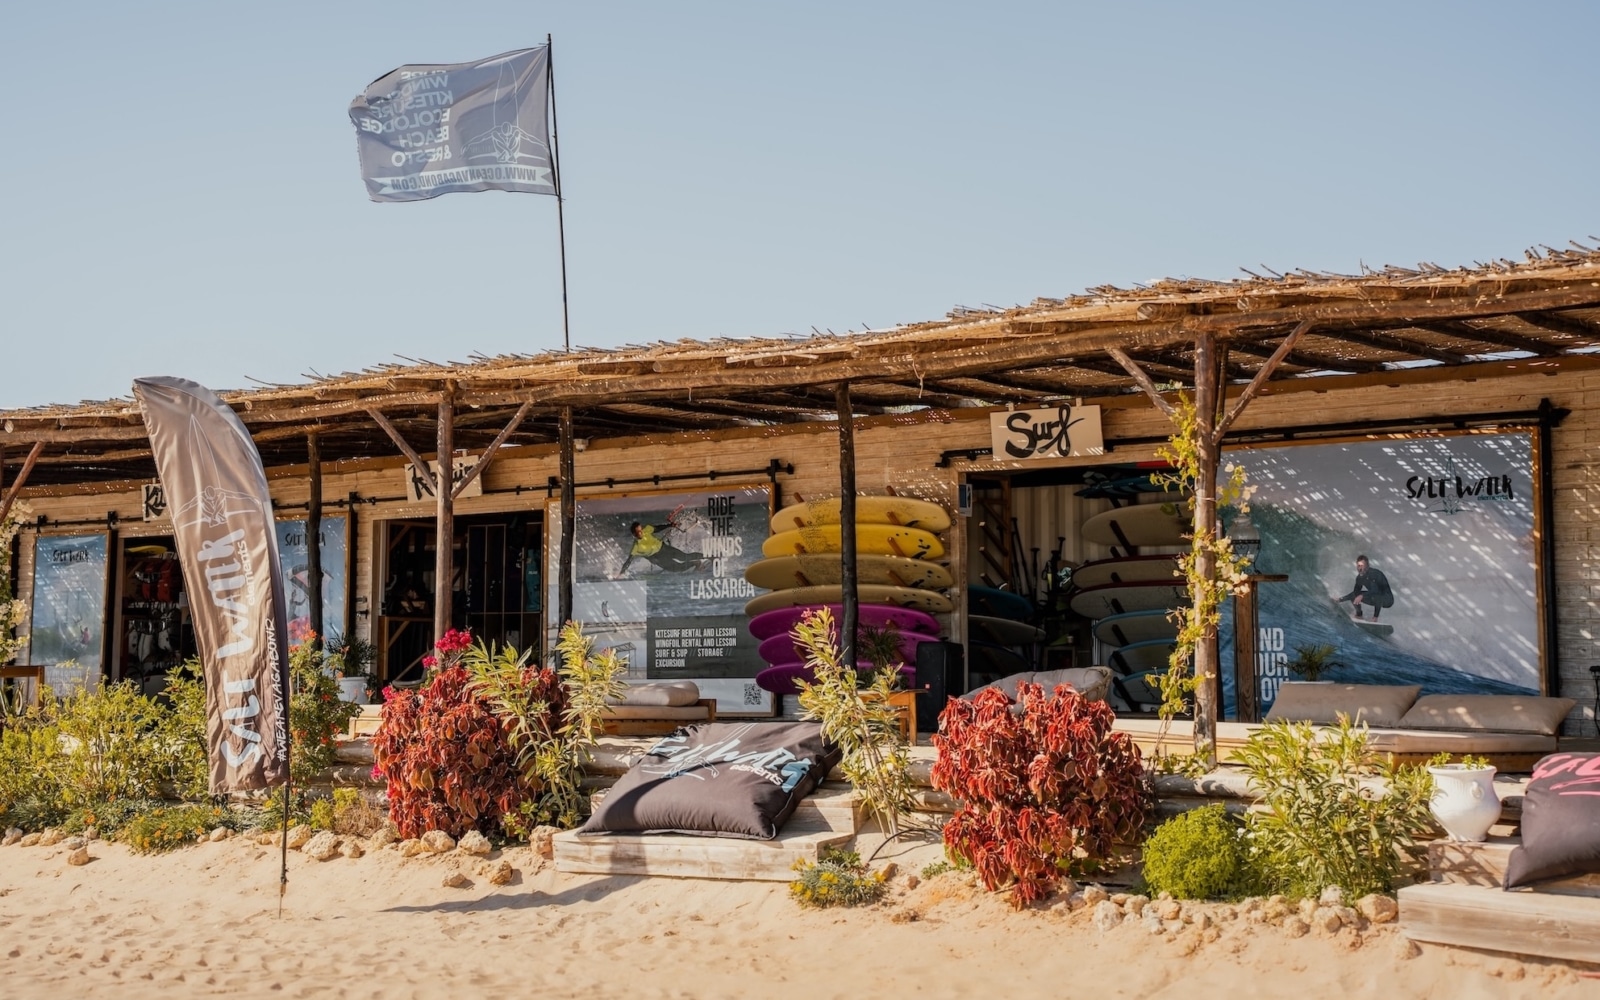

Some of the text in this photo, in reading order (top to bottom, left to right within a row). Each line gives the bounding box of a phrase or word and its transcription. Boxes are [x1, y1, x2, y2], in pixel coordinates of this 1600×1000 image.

[1005, 403, 1085, 458] Surf
[1406, 474, 1514, 500] SALT WATER
[708, 496, 736, 517] RIDE
[710, 517, 734, 537] THE
[702, 536, 743, 558] WINDS
[237, 540, 255, 606] elements
[713, 558, 729, 579] OF
[690, 578, 756, 600] LASSARGA
[655, 627, 737, 638] KITESURF RENTAL AND LESSON
[655, 638, 737, 649] WINGFOIL RENTAL AND LESSON
[197, 528, 262, 768] SALT WATER
[655, 649, 670, 658] SURF
[671, 649, 675, 657] &
[676, 648, 688, 657] SUP
[697, 648, 723, 657] STORAGE
[655, 658, 686, 668] EXCURSION
[1254, 652, 1290, 677] OUR
[265, 617, 287, 763] #WEAREVAGABOND
